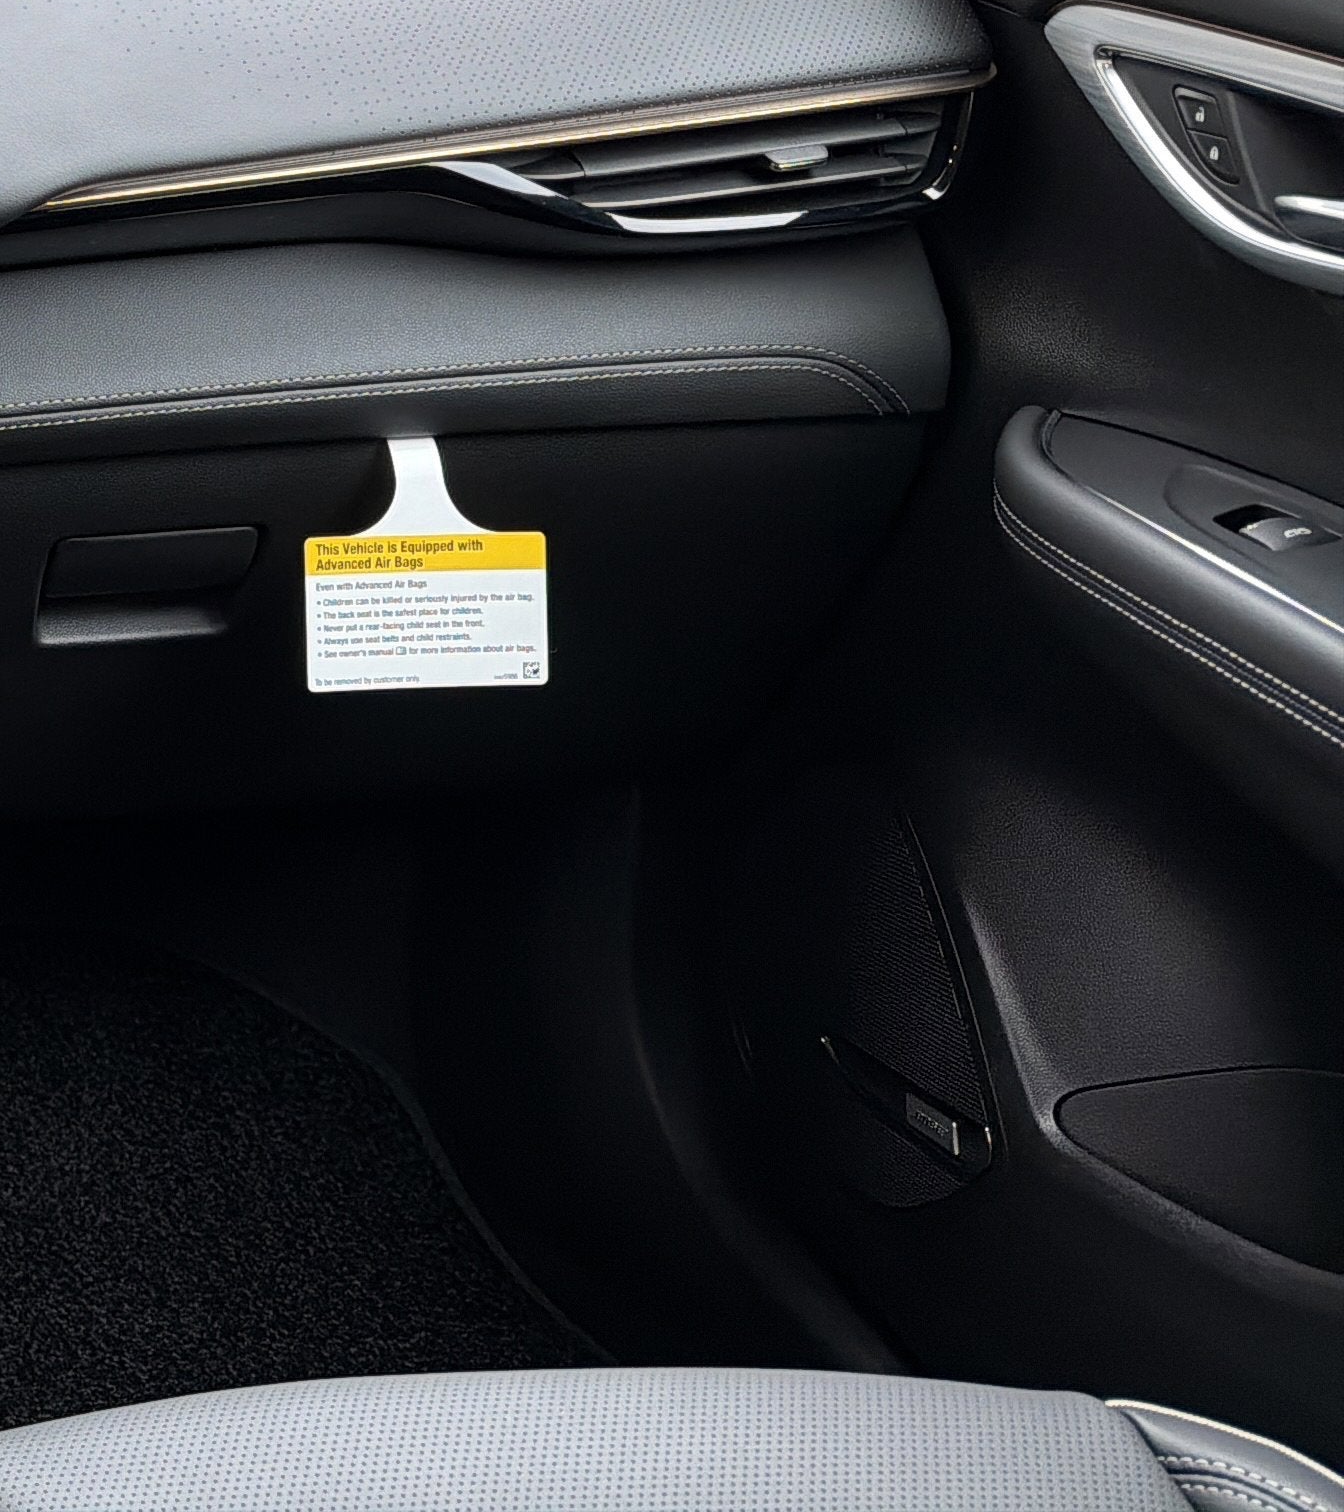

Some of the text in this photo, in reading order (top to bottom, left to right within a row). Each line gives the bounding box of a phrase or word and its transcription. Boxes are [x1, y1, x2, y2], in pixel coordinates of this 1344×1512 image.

[315, 539, 483, 556] This Vehicle is Equipped with
[316, 556, 424, 571] Advanced Air Bags
[315, 579, 428, 592] Even with Advanced Air Bags
[323, 598, 353, 606] Children
[356, 598, 369, 606] can
[371, 597, 380, 605] be
[382, 596, 403, 604] killed
[415, 594, 448, 604] seriously
[450, 593, 477, 603] injured
[479, 593, 488, 603] by
[490, 593, 503, 602] the
[505, 593, 515, 601] air
[517, 592, 534, 602] bag.
[323, 611, 336, 619] The
[338, 611, 355, 619] back
[357, 610, 372, 618] seat
[382, 609, 393, 617] the
[395, 608, 417, 617] safest
[419, 608, 438, 617] place
[440, 607, 450, 615] for
[452, 607, 484, 615] children.
[323, 624, 344, 633] Never
[345, 624, 358, 633] put
[365, 622, 404, 631] rear-facing
[406, 621, 424, 629] child
[425, 620, 441, 628] seat
[451, 620, 464, 628] the
[464, 619, 485, 628] front.
[324, 637, 349, 646] Always
[350, 637, 363, 645] use
[365, 636, 380, 644] seat
[401, 634, 415, 642] and
[416, 634, 434, 642] child
[435, 633, 472, 641] restraints.
[324, 650, 337, 658] See
[368, 648, 394, 656] manual
[408, 647, 419, 655] for
[420, 646, 439, 654] more
[440, 645, 481, 654] information
[483, 645, 504, 653] about
[517, 644, 537, 653] bags.
[315, 677, 322, 686] To
[323, 678, 332, 686] be
[334, 676, 363, 685] removed
[364, 676, 373, 686] by
[373, 675, 403, 684] customer
